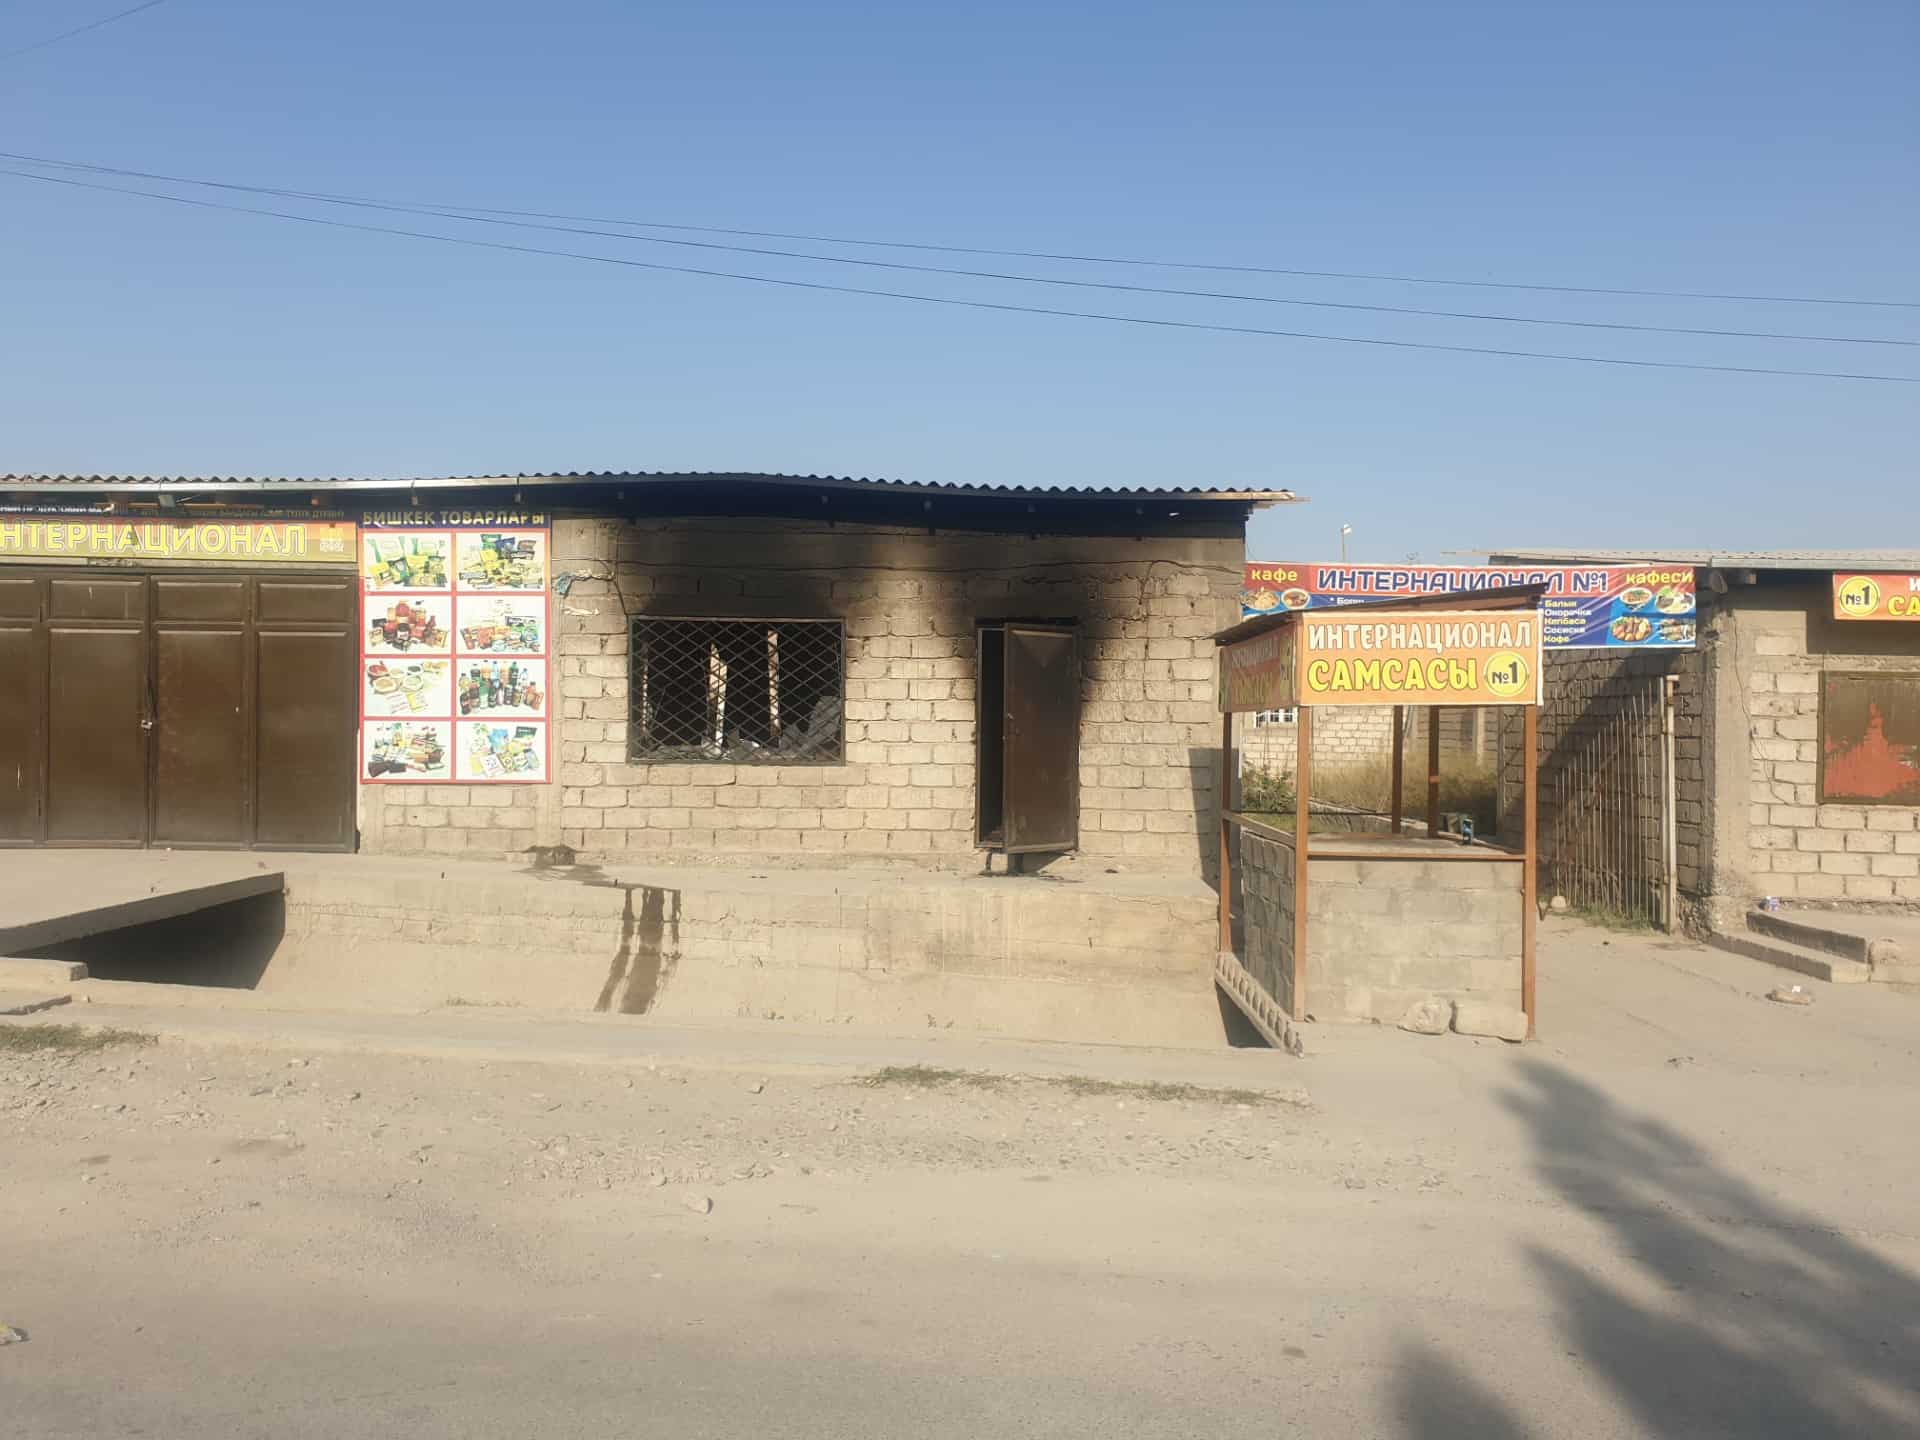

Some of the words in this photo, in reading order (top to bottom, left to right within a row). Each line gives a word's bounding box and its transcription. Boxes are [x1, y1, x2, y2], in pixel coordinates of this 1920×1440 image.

[1251, 569, 1298, 584] кафе
[1572, 571, 1608, 597] №1
[1625, 570, 1694, 586] кафеси
[1845, 584, 1871, 606] №1
[1308, 621, 1532, 654] ИНТЕРНАЦИОНАЛ
[1307, 657, 1479, 692] САМСАСЫ
[1491, 660, 1520, 685] №1
